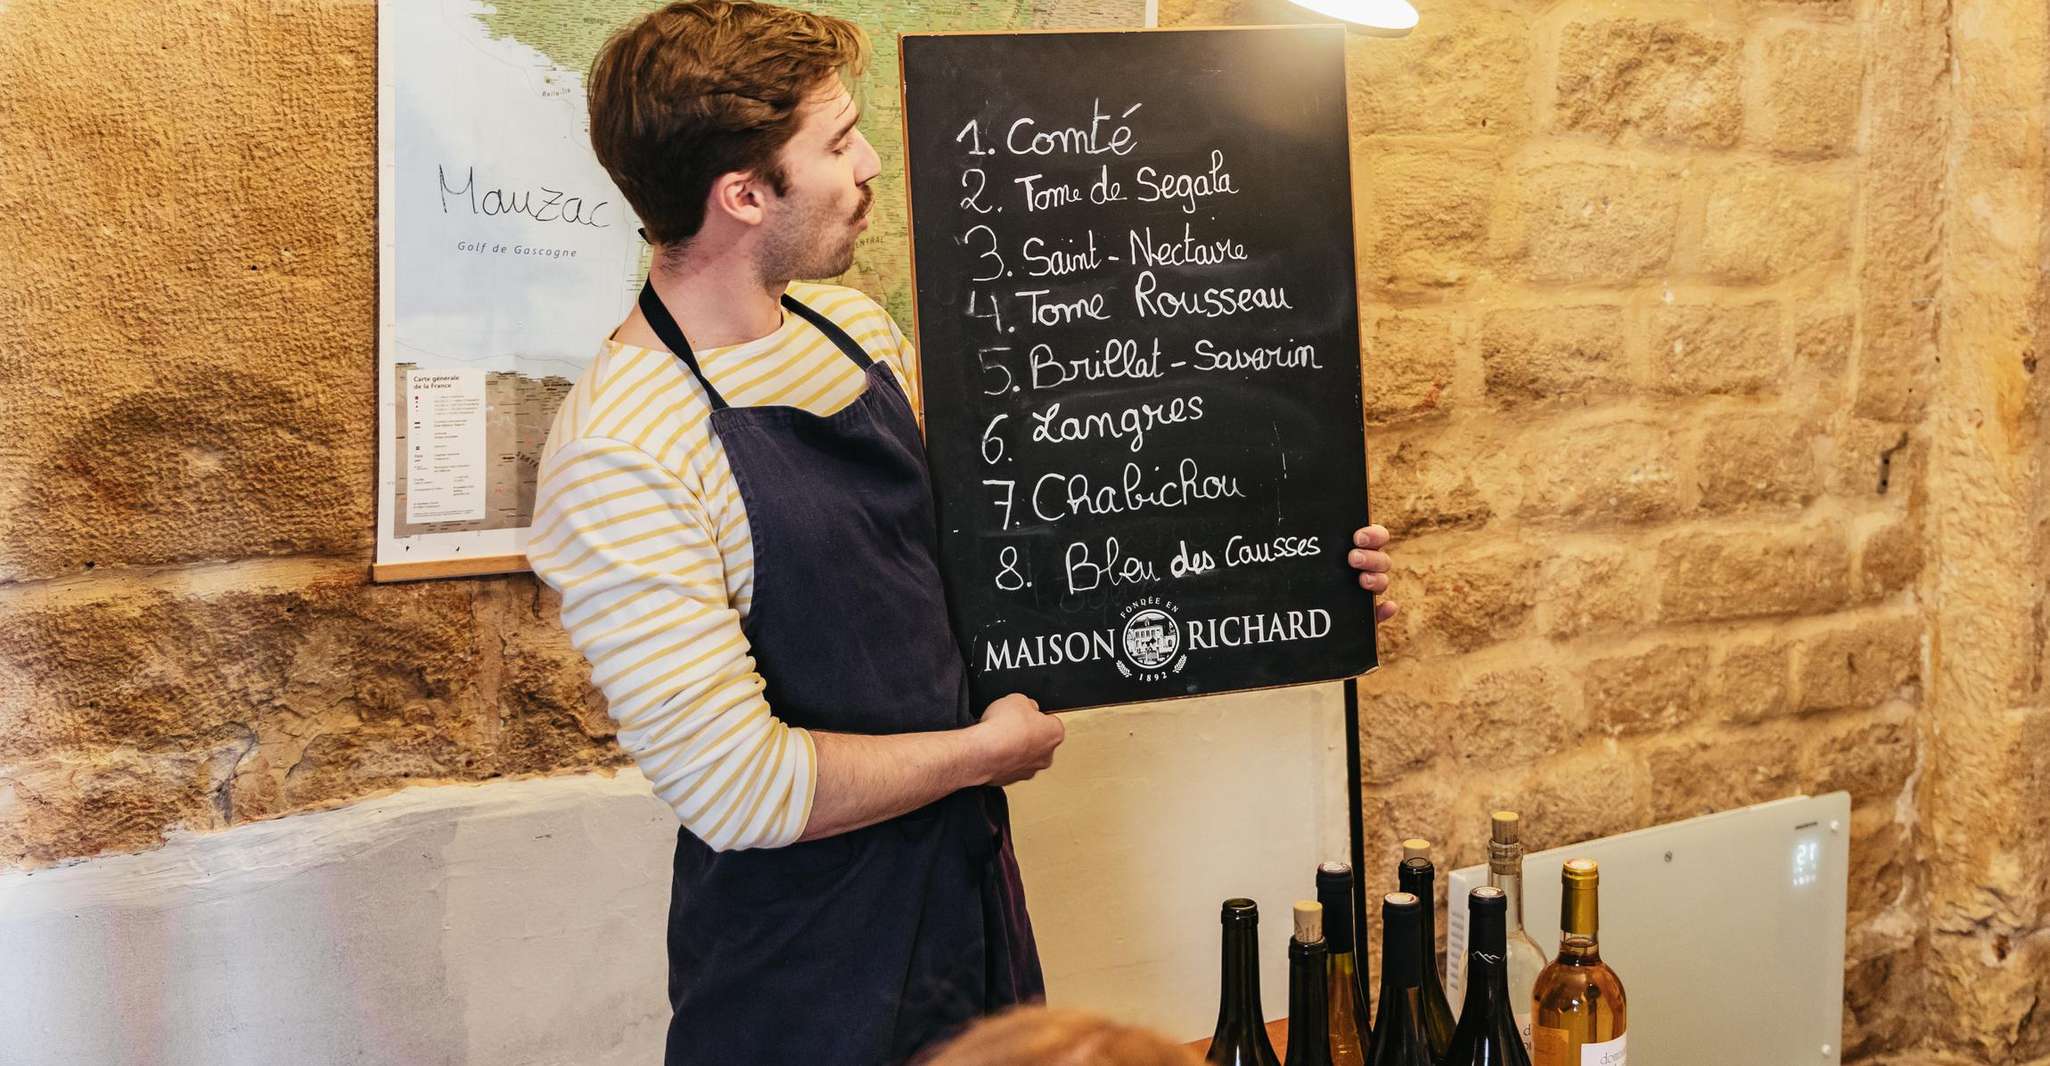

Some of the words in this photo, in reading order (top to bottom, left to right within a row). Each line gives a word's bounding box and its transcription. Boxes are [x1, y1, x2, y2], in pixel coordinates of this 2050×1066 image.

[956, 119, 996, 155] 1.
[1007, 97, 1143, 156] Comté
[438, 163, 610, 229] Mauzac
[960, 168, 1002, 214] 2.
[1014, 173, 1083, 213] Tome
[1090, 164, 1128, 205] de
[1136, 149, 1240, 214] Segala
[457, 240, 487, 254] Golf
[492, 242, 507, 254] de
[513, 244, 578, 259] Gascogne
[964, 224, 1013, 282] 3.
[965, 289, 1016, 334] 4.
[1015, 288, 1112, 327] Tome
[1135, 270, 1294, 319] Rousseau
[978, 346, 1021, 396] 5.
[981, 413, 1014, 465] 6.
[1032, 395, 1204, 452] Langres
[982, 479, 1021, 531] 7.
[1032, 457, 1248, 522] Chabichou
[995, 545, 1033, 591] 8.
[1065, 536, 1161, 595] Bleu
[1170, 540, 1216, 579] des
[1224, 535, 1322, 568] Causses
[1120, 595, 1161, 619] FONDÉE
[1166, 600, 1179, 613] EN
[983, 628, 1116, 672] MAISON
[1185, 607, 1332, 651] RICHARD
[1138, 671, 1168, 682] 1892
